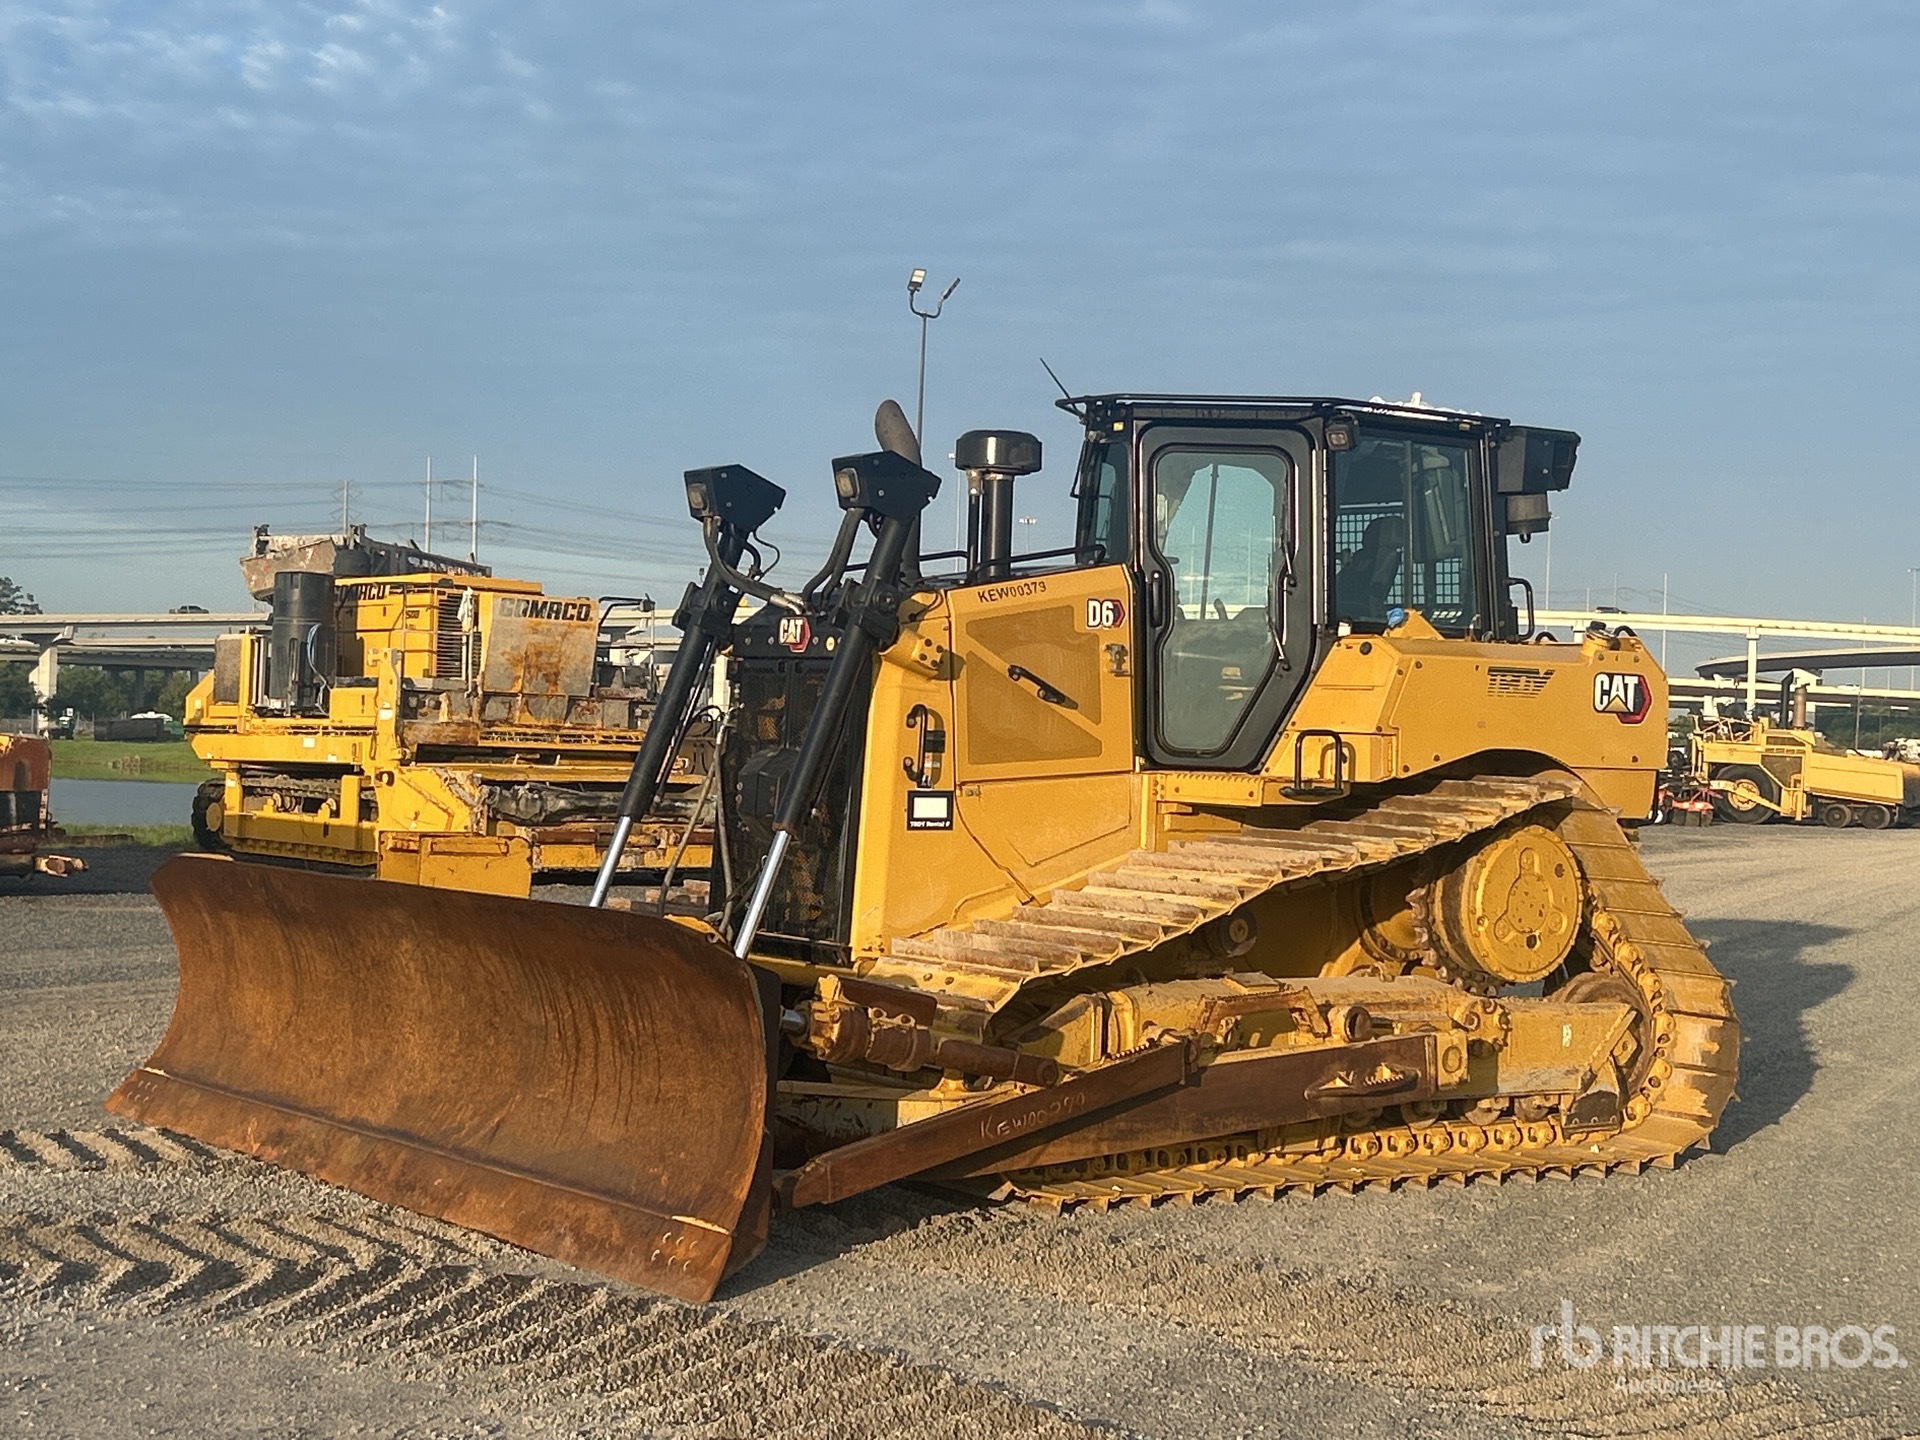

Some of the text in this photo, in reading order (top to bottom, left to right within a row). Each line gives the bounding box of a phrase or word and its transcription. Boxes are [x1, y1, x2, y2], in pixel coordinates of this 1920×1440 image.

[977, 581, 1047, 603] KEW00379
[1087, 599, 1114, 628] D6
[779, 618, 803, 644] CAT
[1594, 673, 1639, 712] CAT
